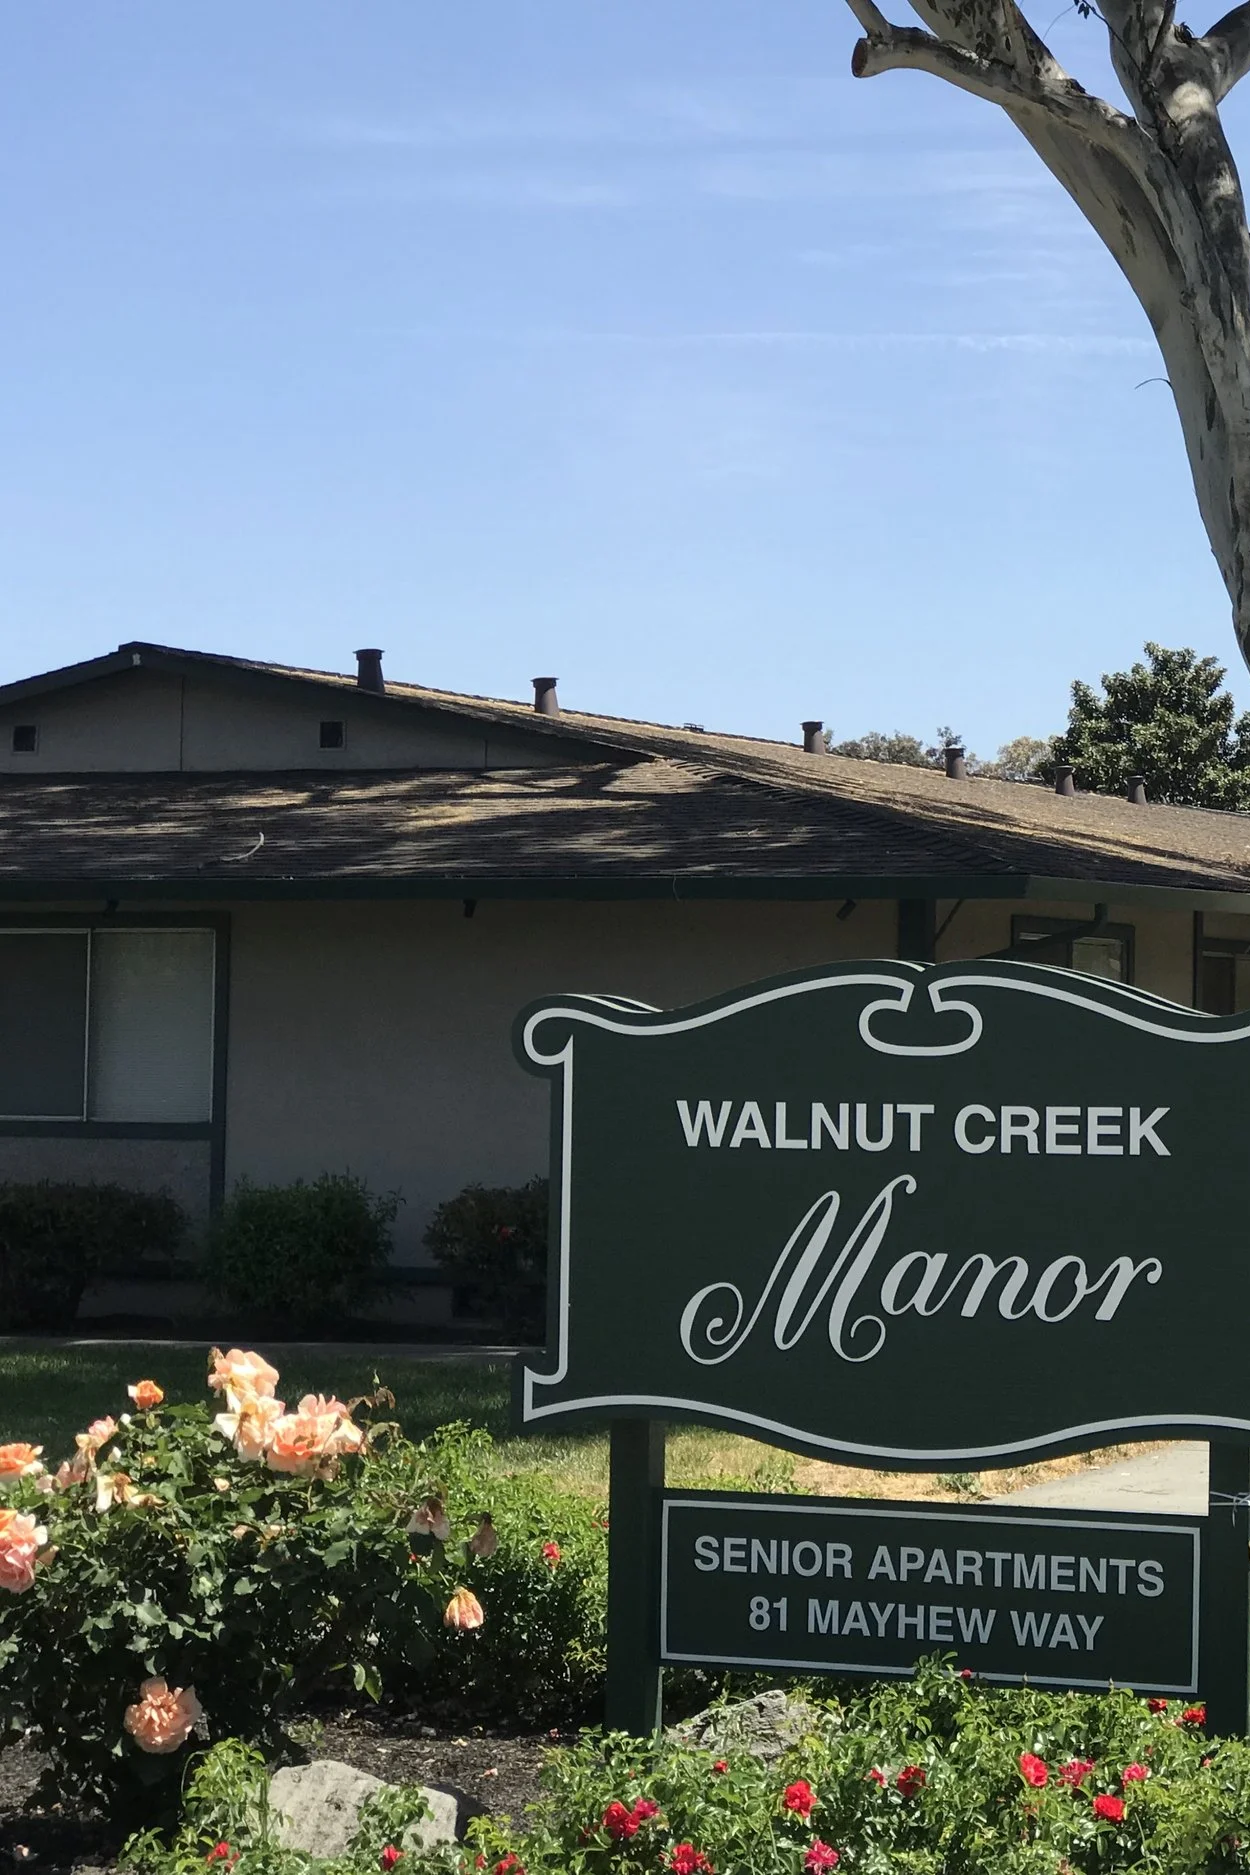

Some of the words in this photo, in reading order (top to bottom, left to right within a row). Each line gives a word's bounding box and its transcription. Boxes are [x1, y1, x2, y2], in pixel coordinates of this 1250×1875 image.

[676, 1100, 935, 1152] WALNUT
[954, 1104, 1172, 1156] CREEK
[680, 1174, 1163, 1365] Manor
[694, 1535, 853, 1578] SENIOR
[867, 1545, 1164, 1597] APARTMENTS
[749, 1596, 788, 1632] 81
[807, 1598, 997, 1644] MAYHEW
[1010, 1610, 1105, 1651] WAY
